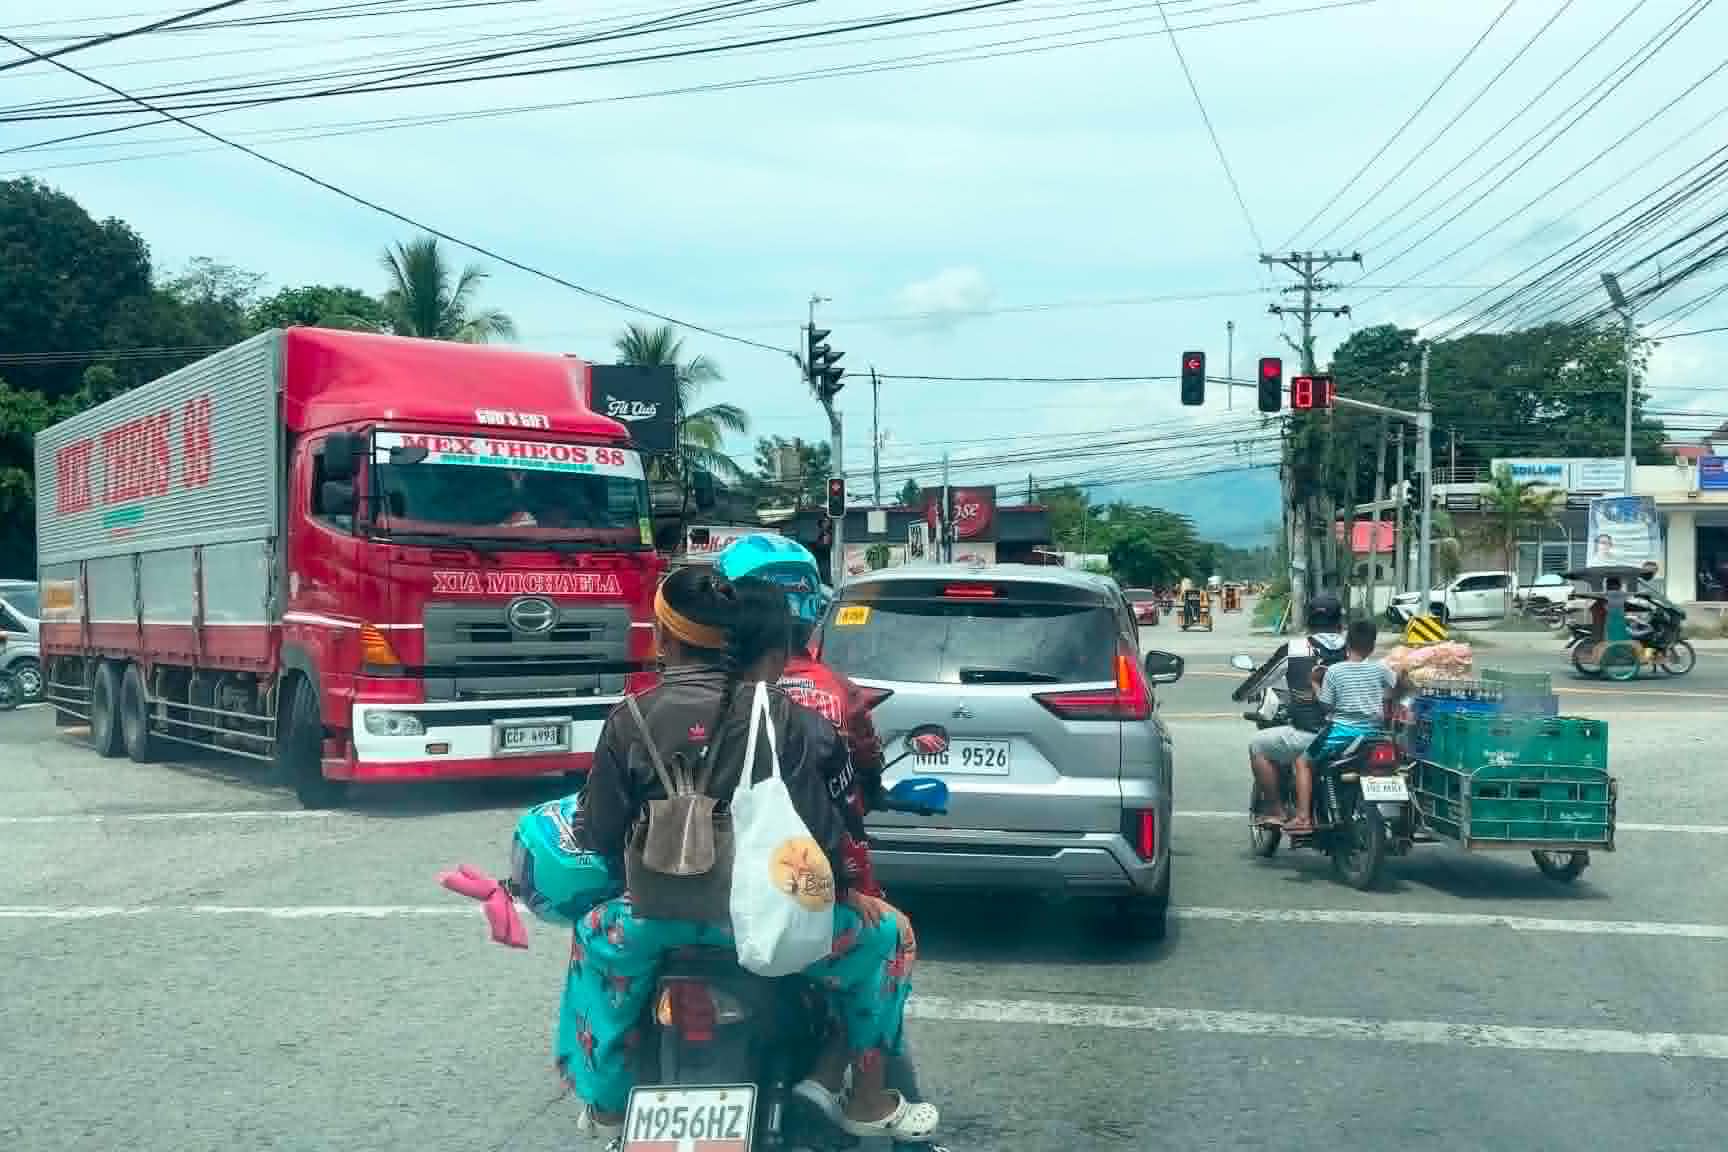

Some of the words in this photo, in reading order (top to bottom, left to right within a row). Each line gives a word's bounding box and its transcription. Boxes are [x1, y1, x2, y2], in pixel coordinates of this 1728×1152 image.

[184, 394, 210, 488] 88
[485, 441, 588, 463] THEOS
[595, 448, 625, 466] 88
[432, 571, 482, 593] XIA
[487, 573, 624, 595] MICHAELA
[962, 746, 1006, 768] 9526
[633, 1104, 744, 1140] M956HZ
